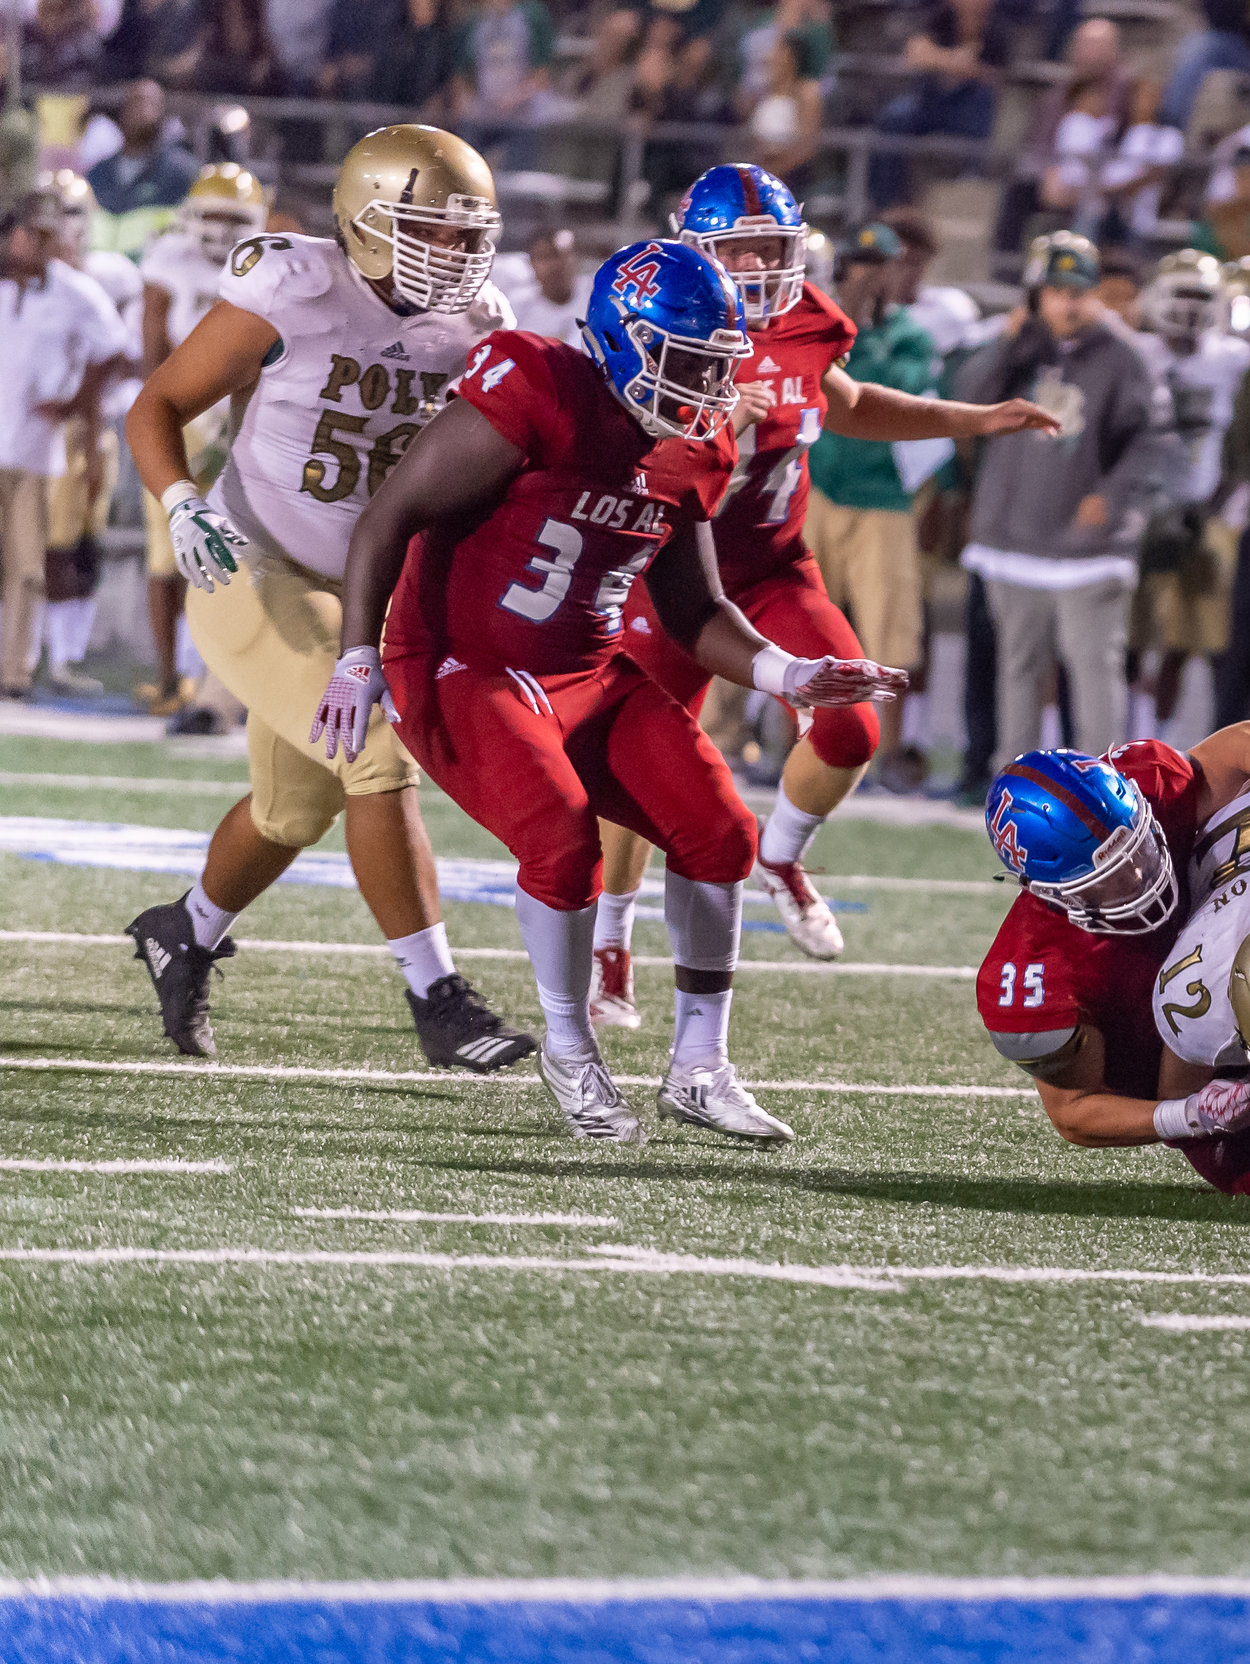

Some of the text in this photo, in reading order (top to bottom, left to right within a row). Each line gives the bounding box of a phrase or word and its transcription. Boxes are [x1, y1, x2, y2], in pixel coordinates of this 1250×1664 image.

[611, 242, 662, 308] LA
[320, 353, 449, 416] POLY
[464, 344, 517, 394] 34
[570, 491, 667, 535] LOS AL
[991, 787, 1028, 874] LA
[998, 961, 1046, 1009] 35
[1159, 944, 1212, 1038] 12
